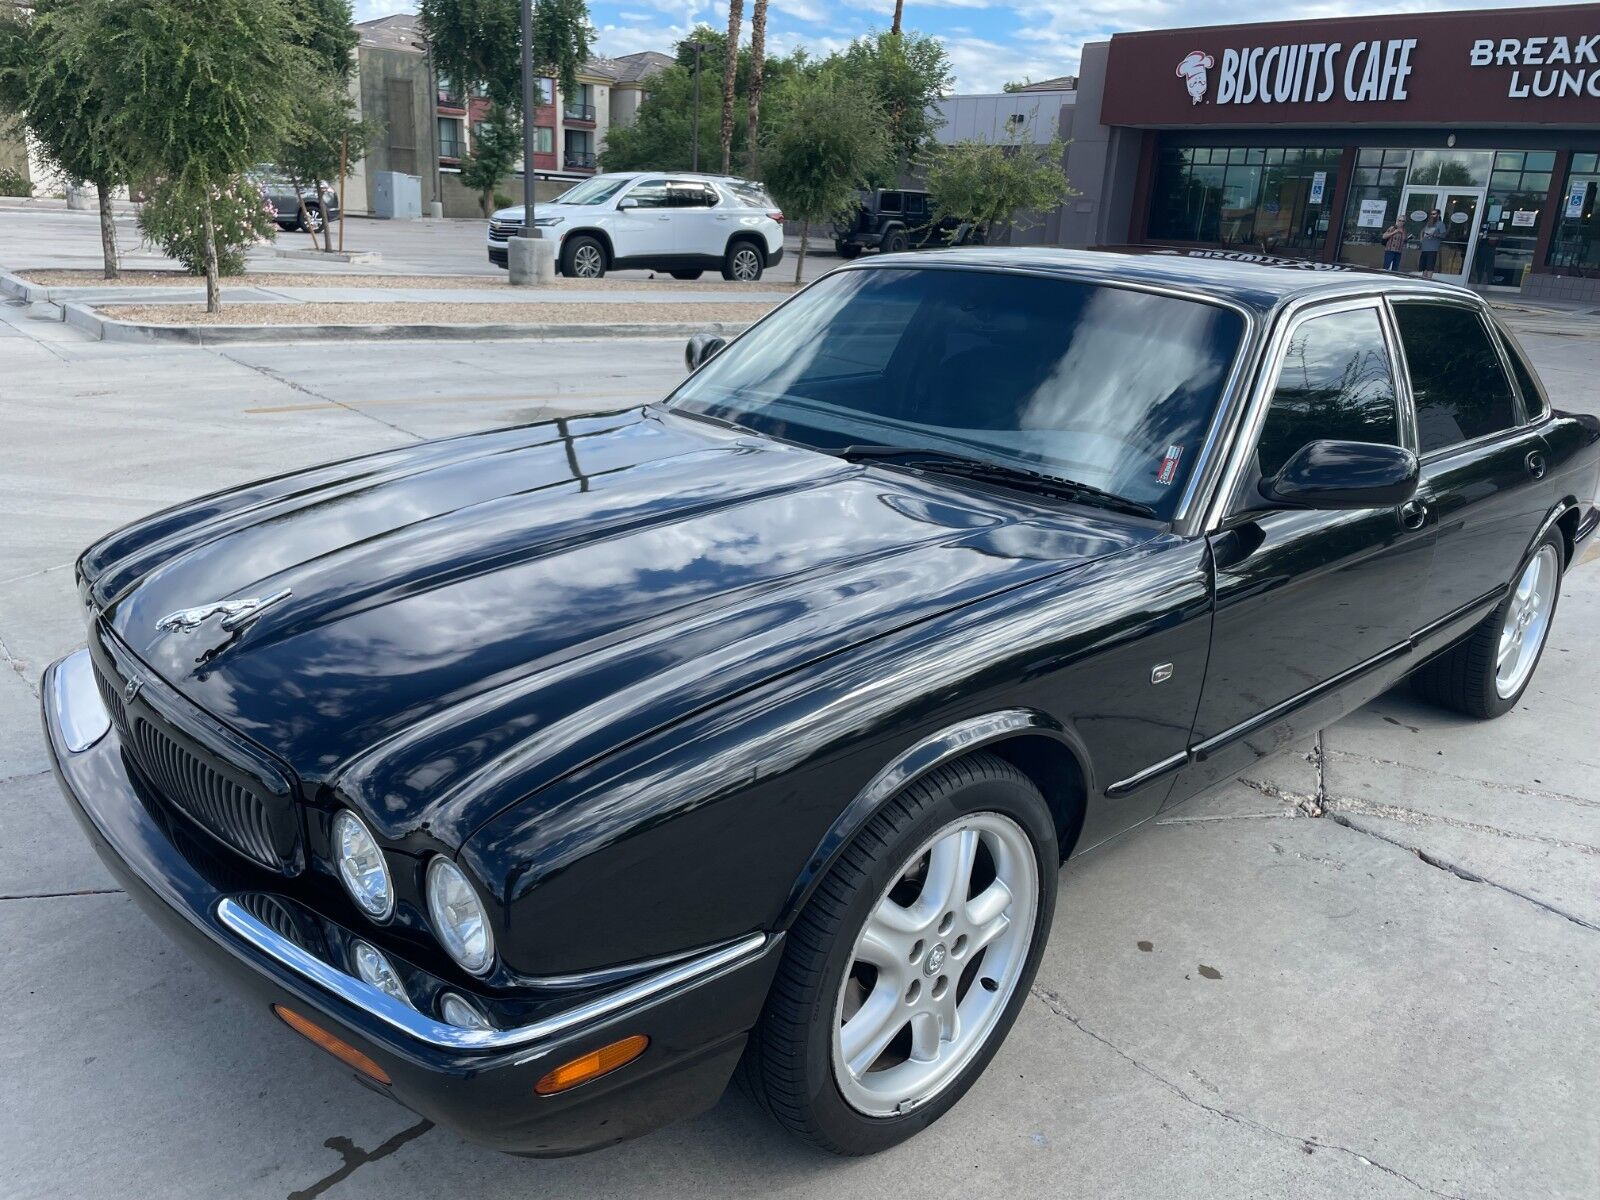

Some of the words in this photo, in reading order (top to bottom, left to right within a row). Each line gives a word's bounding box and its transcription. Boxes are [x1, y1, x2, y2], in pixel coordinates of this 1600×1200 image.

[1216, 42, 1342, 105] BISCUITS
[1344, 38, 1418, 102] CAFE
[1470, 34, 1600, 66] BREAK
